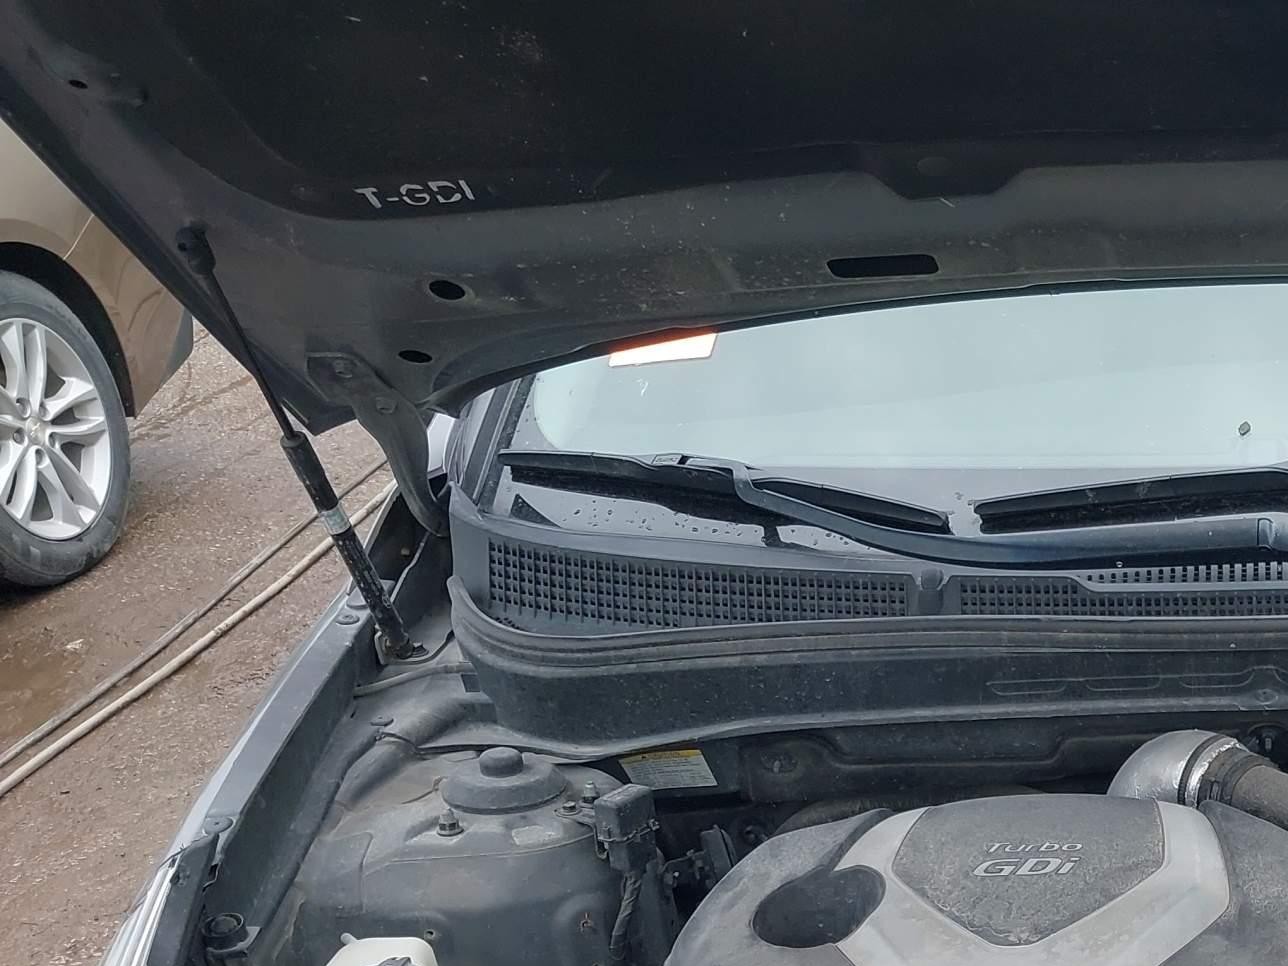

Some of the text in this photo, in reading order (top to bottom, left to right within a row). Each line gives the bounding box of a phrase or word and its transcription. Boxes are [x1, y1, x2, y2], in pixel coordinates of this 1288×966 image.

[354, 180, 475, 208] T-GDI
[986, 841, 1083, 853] Turbo
[972, 856, 1082, 876] GDi
